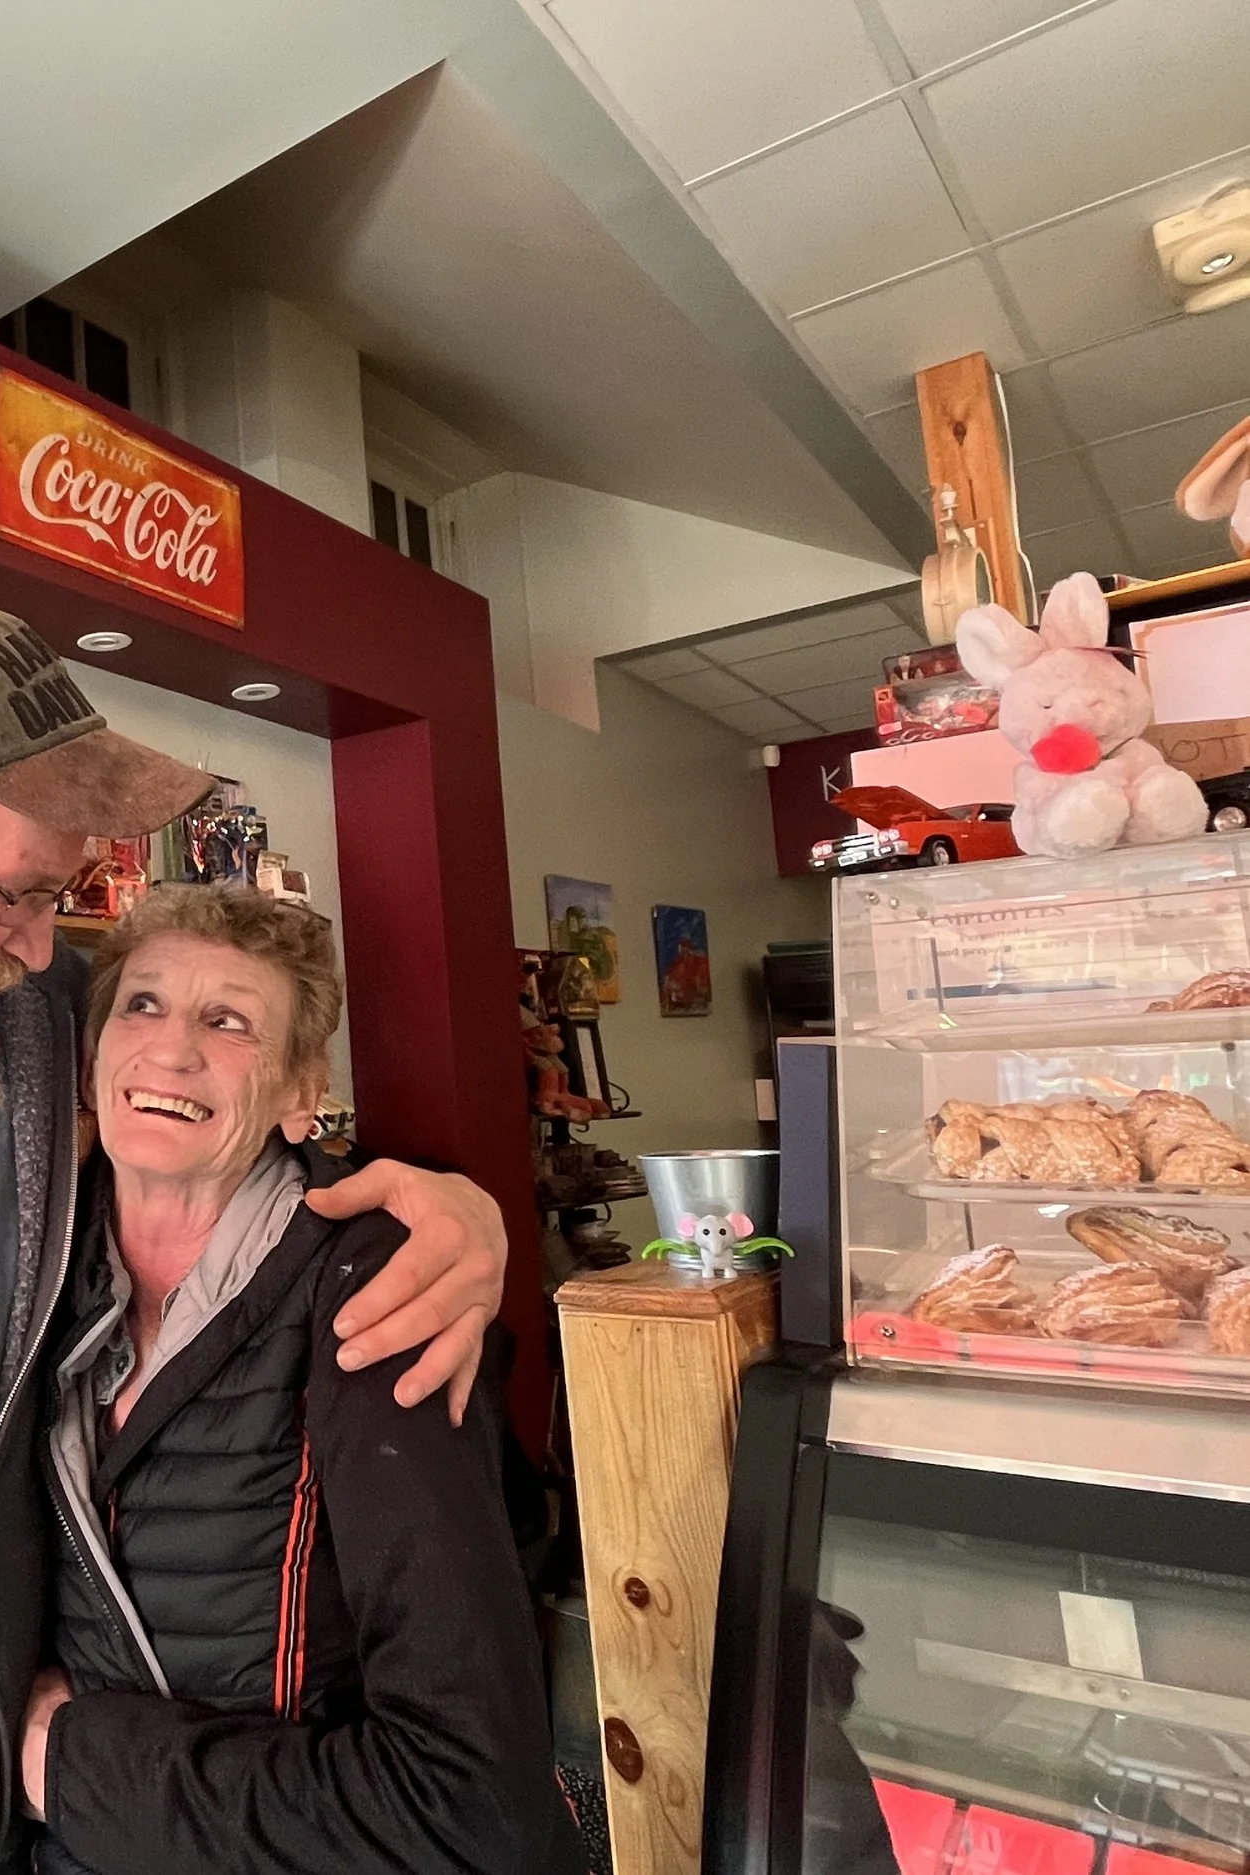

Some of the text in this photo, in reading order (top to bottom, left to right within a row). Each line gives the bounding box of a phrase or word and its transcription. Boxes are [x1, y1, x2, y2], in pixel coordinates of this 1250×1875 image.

[76, 431, 151, 476] DRINK
[18, 433, 222, 587] Coca-Cola
[7, 673, 97, 740] DAVI
